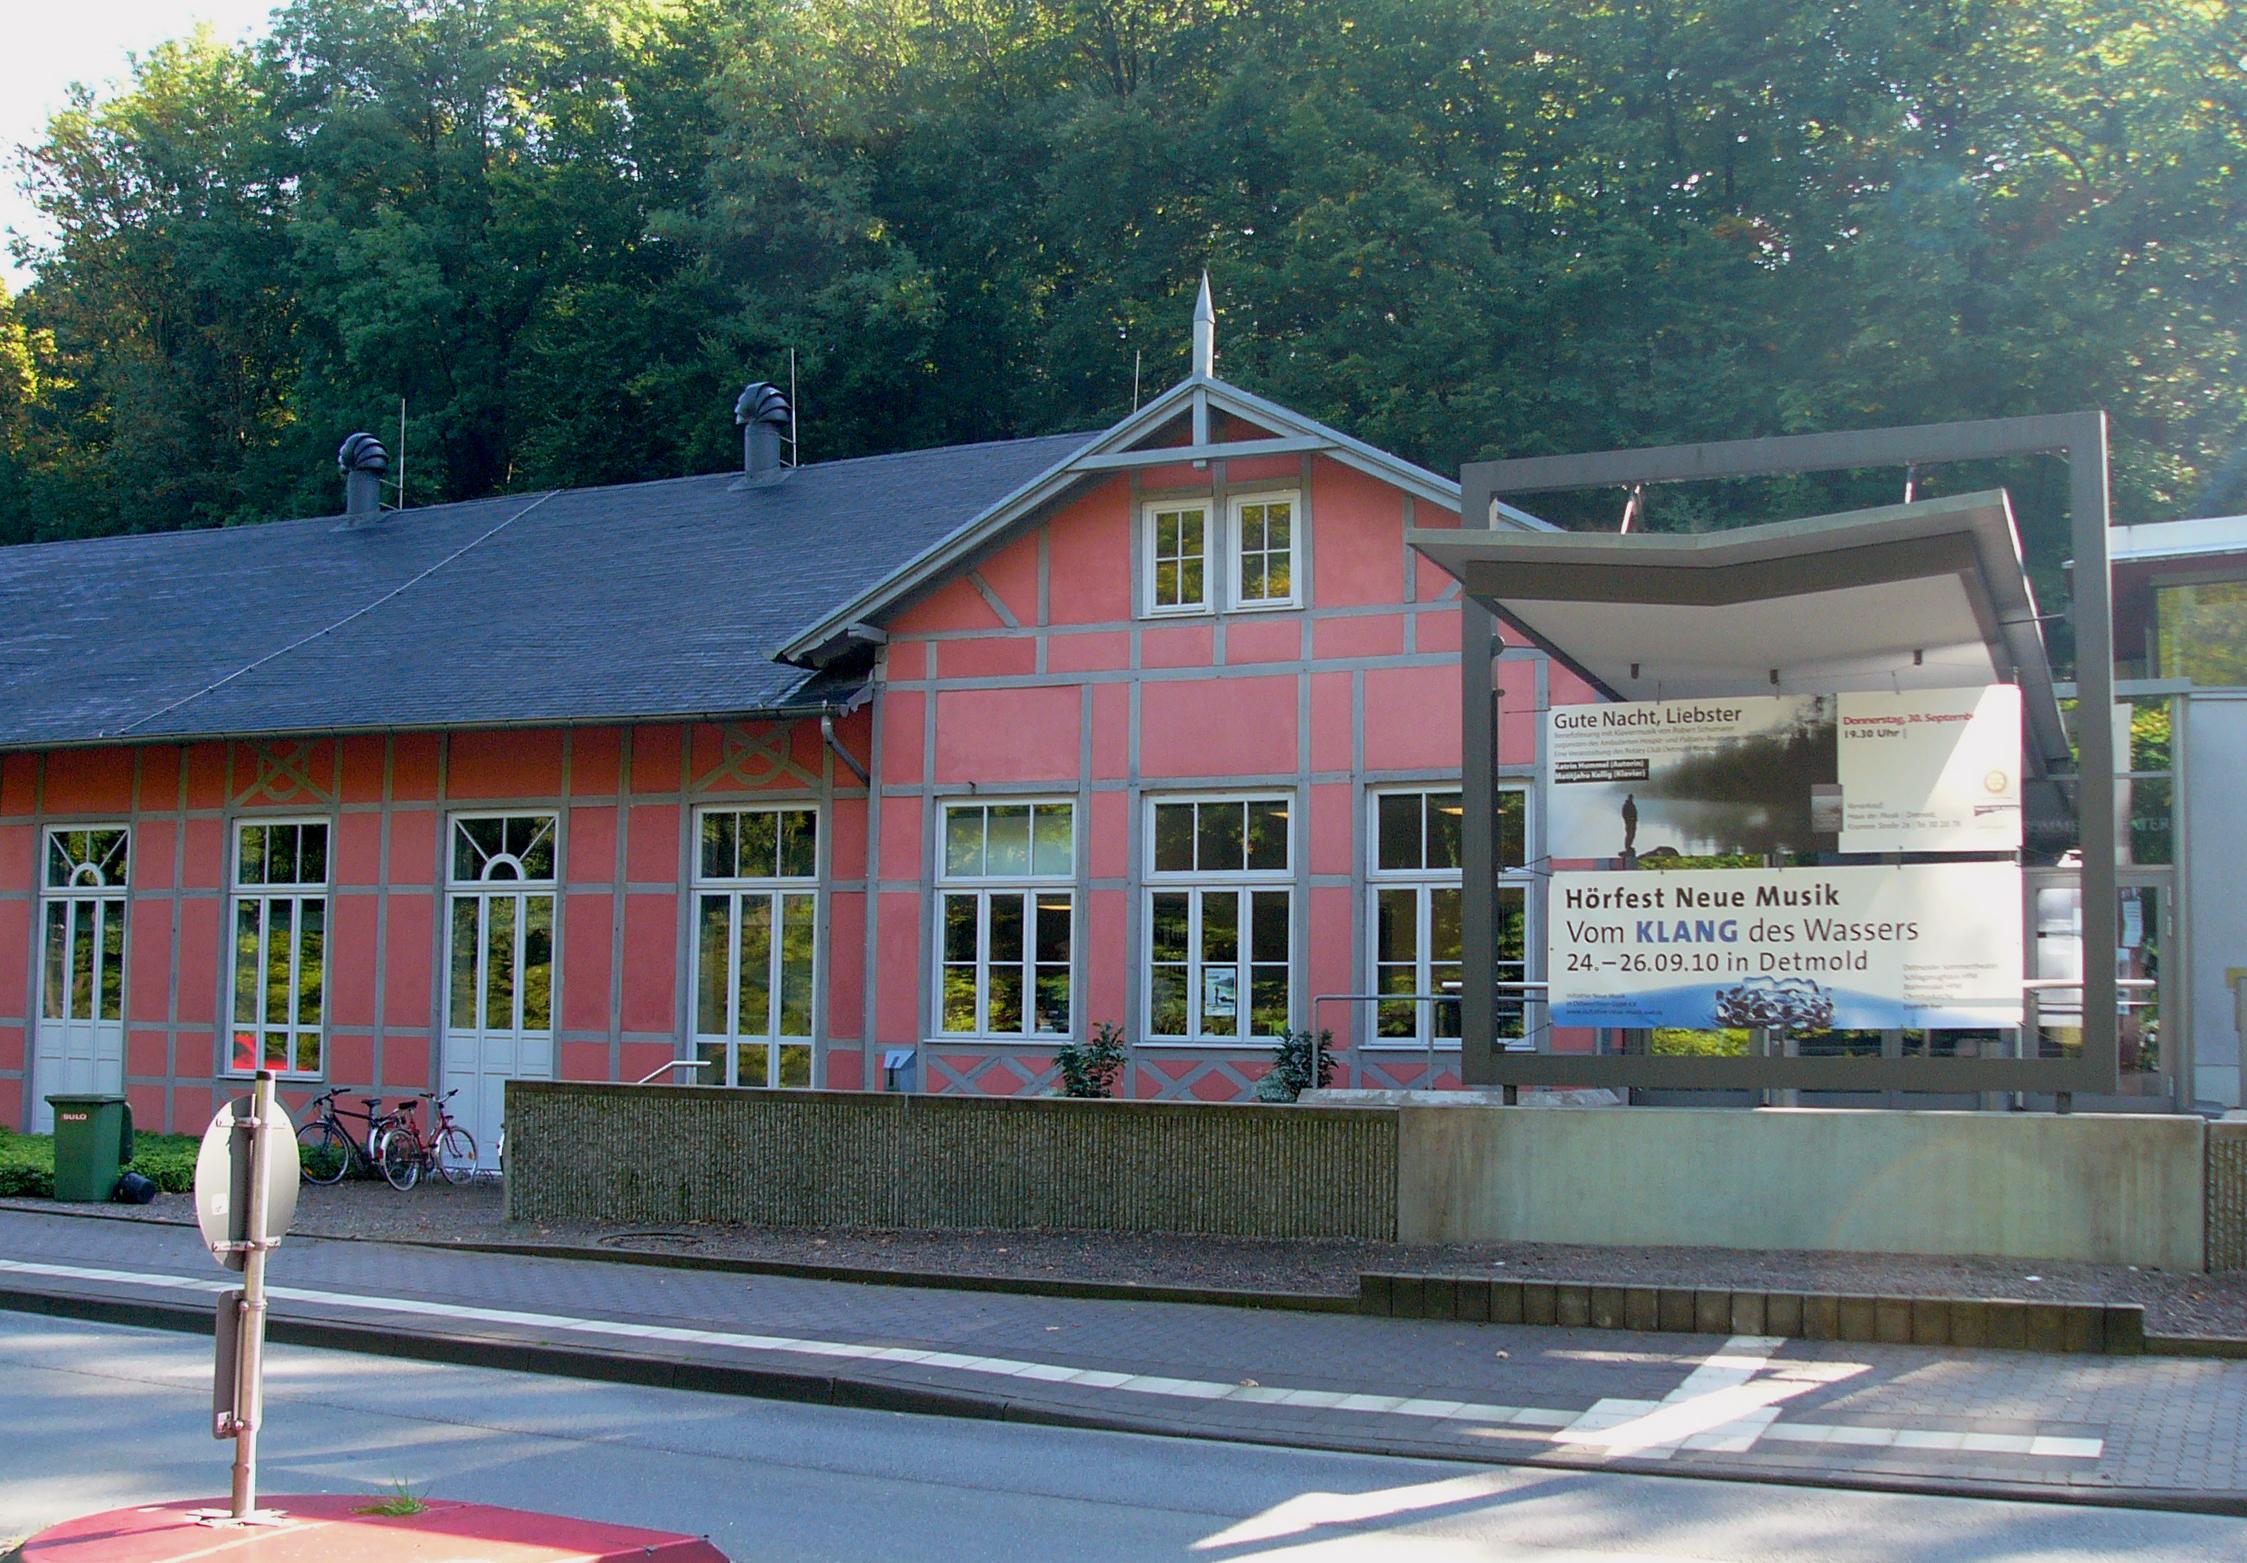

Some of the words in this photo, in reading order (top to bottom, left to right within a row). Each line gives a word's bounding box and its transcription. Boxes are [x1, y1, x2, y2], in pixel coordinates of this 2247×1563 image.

[1554, 713, 1598, 729] Gute
[1603, 709, 1661, 727] Nacht,
[1666, 706, 1743, 725] Liebster
[1844, 729, 1873, 739] 19.30
[1876, 728, 1899, 738] Uhr
[1566, 887, 1665, 909] Hörfest
[1676, 887, 1745, 908] Neue
[1756, 883, 1840, 907] Musik
[1566, 920, 1624, 944] Vom
[1636, 919, 1738, 943] KLANG
[1749, 917, 1795, 942] des
[1804, 918, 1919, 942] Wassers
[1727, 952, 1749, 971] in
[1760, 949, 1868, 971] Detmold
